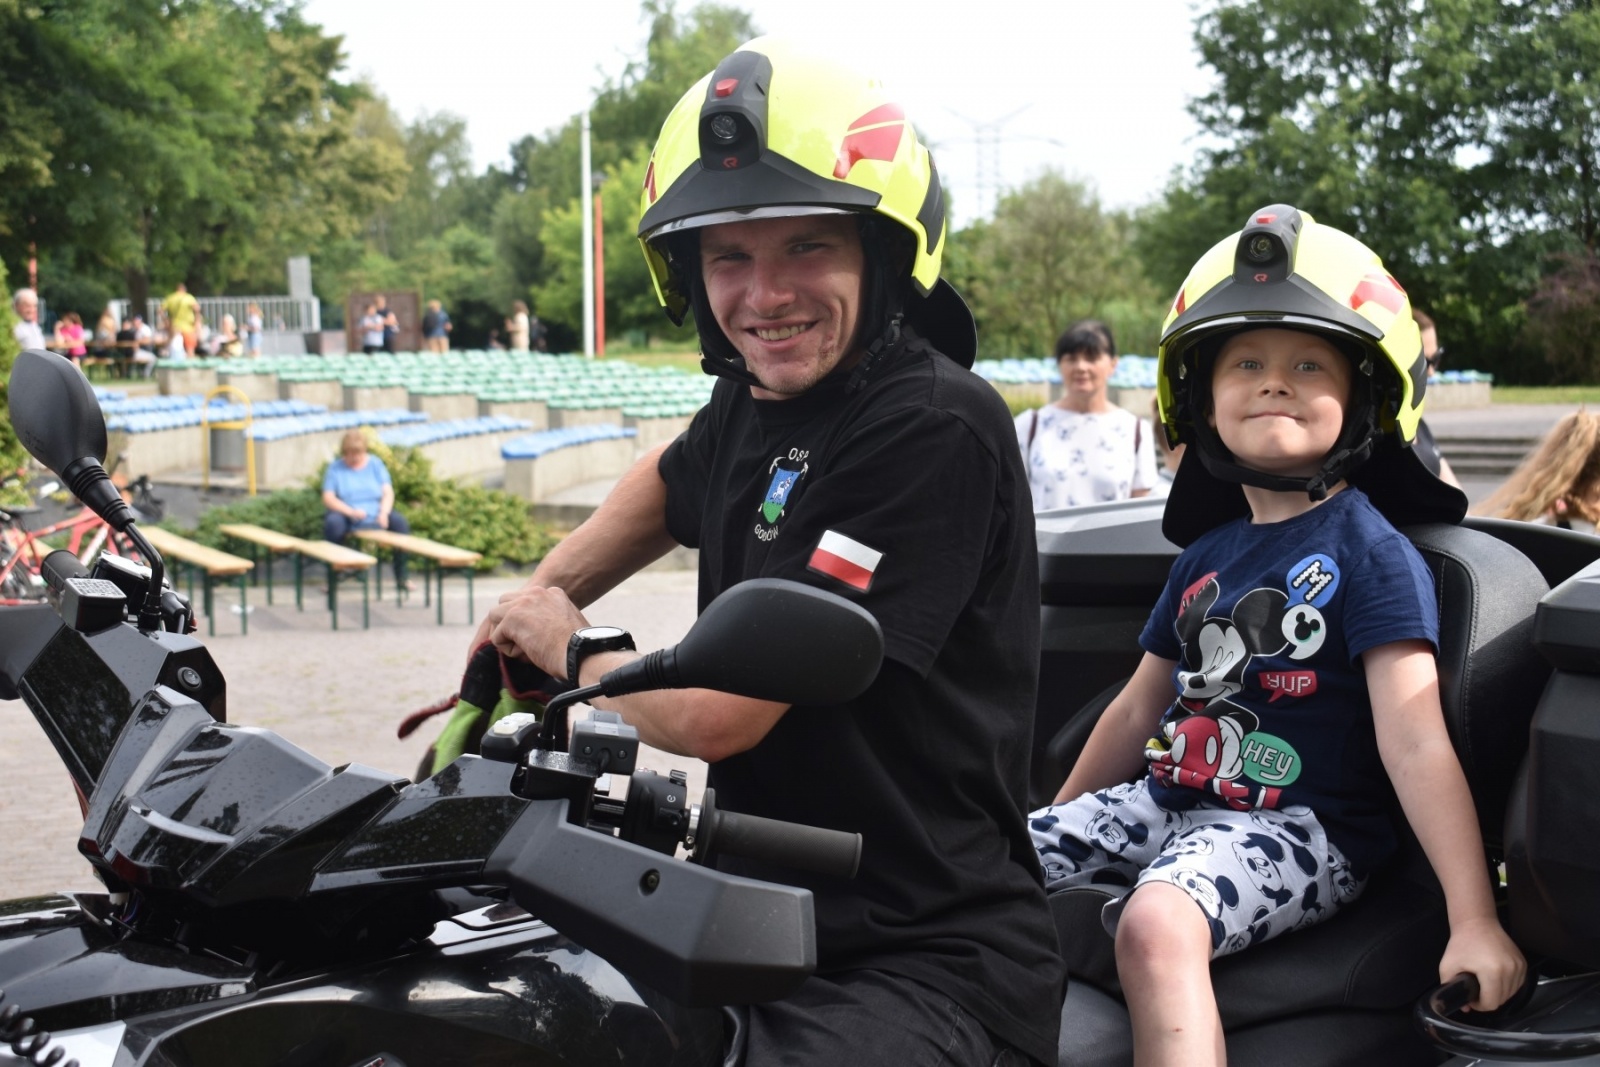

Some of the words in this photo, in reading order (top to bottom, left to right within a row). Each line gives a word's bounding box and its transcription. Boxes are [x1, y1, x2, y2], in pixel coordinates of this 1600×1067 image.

[788, 447, 810, 462] OSP
[1265, 673, 1312, 694] YUP
[1243, 738, 1294, 781] HEY
